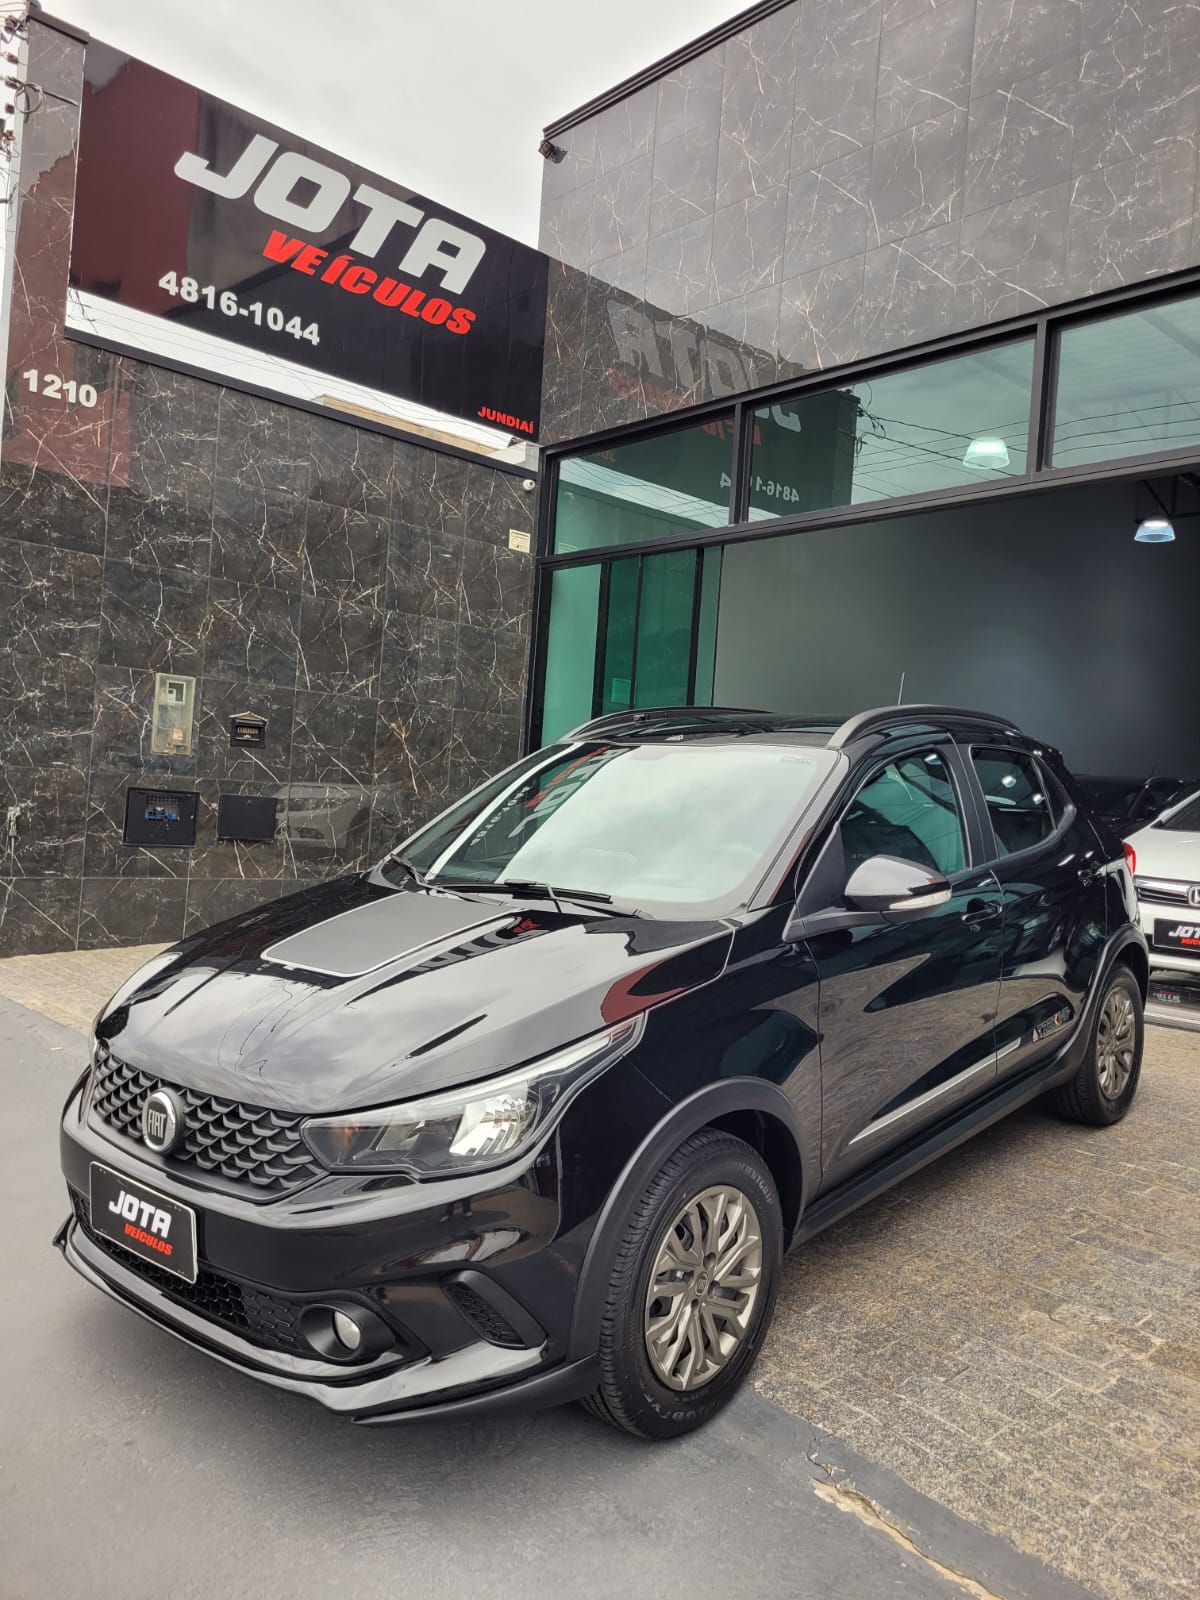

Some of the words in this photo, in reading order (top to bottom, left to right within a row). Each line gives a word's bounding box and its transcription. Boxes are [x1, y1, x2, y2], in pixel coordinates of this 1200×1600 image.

[173, 134, 486, 295] JOTA
[262, 230, 477, 335] VEÍCULOS
[158, 271, 320, 346] 4816-1044
[22, 369, 98, 408] 1210
[477, 406, 534, 434] JUNDIAÍ
[148, 1108, 167, 1139] FIAT
[108, 1190, 172, 1238] JOTA
[124, 1222, 173, 1256] VEÍCULOS
